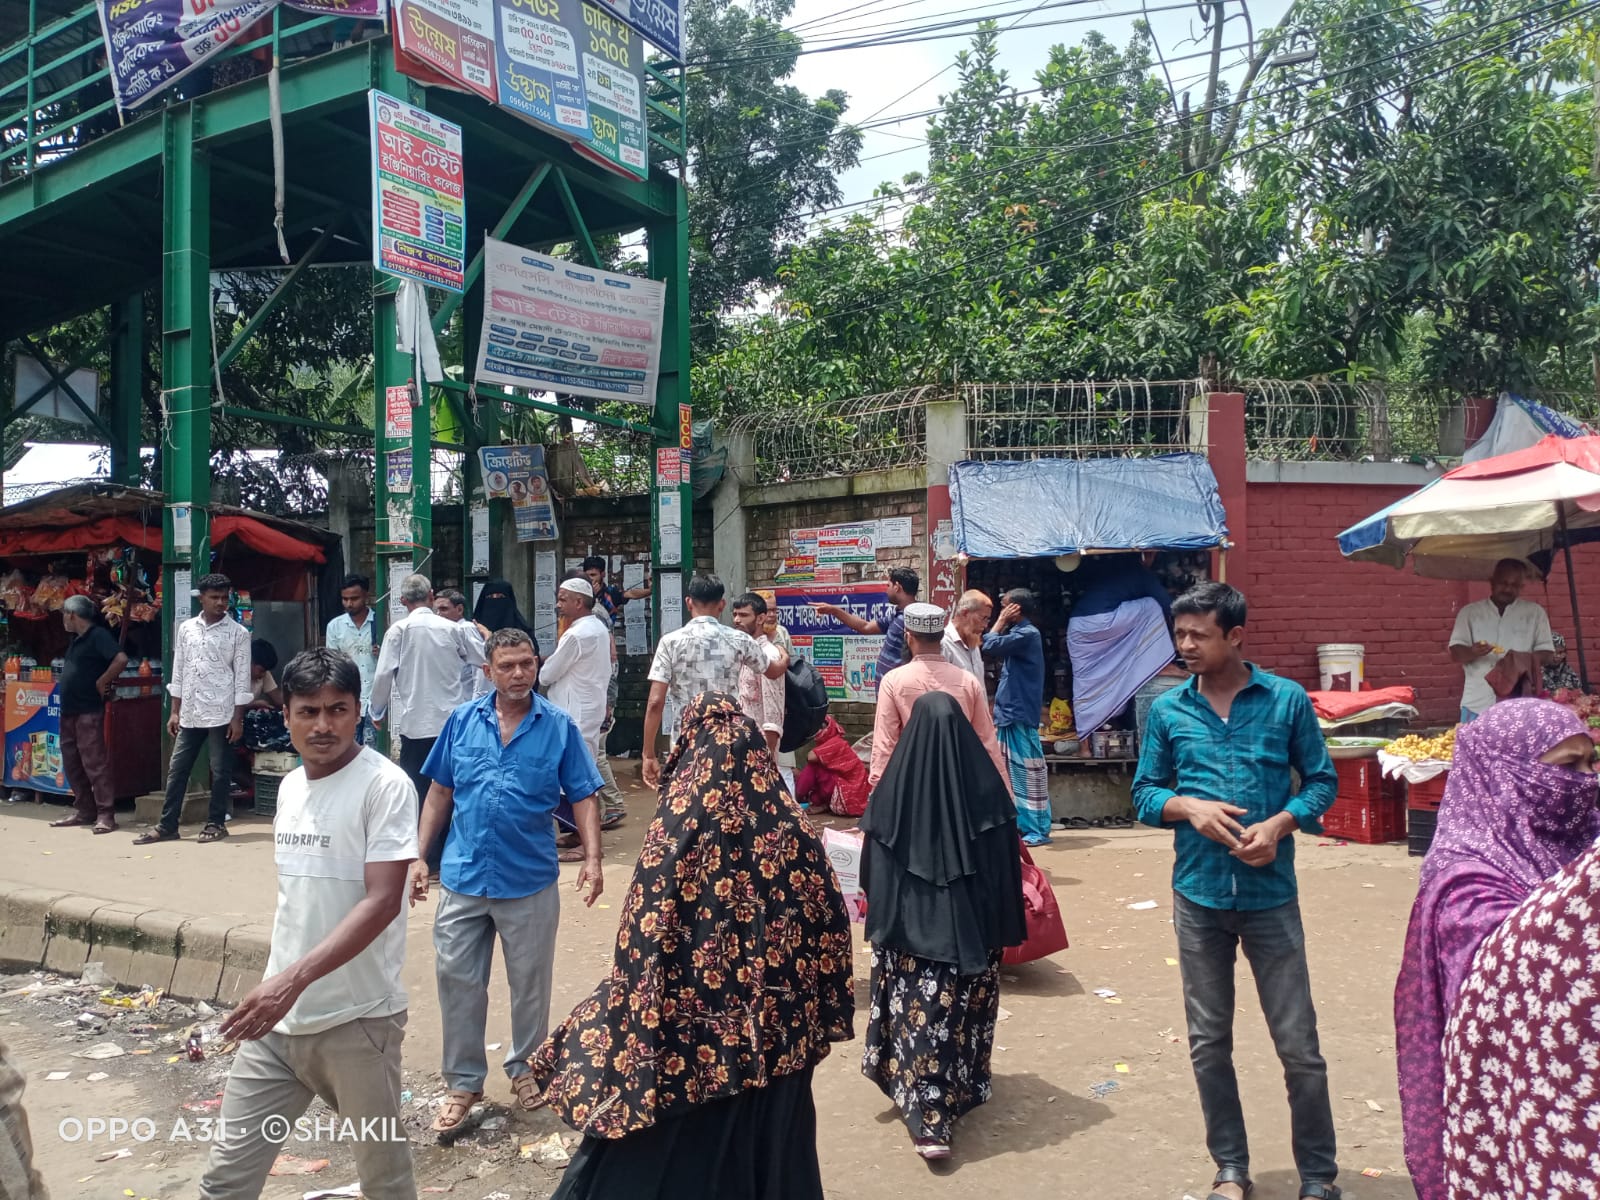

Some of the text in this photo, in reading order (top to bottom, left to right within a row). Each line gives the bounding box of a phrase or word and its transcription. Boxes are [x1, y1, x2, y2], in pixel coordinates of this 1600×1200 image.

[407, 7, 457, 60] উন্মেষ
[590, 31, 629, 68] ১৭০৫
[504, 62, 551, 106] উদ্ভাস
[590, 114, 618, 145] দ্ভাস
[681, 410, 690, 448] UCC
[485, 451, 531, 468] ক্রিয়েটিভ
